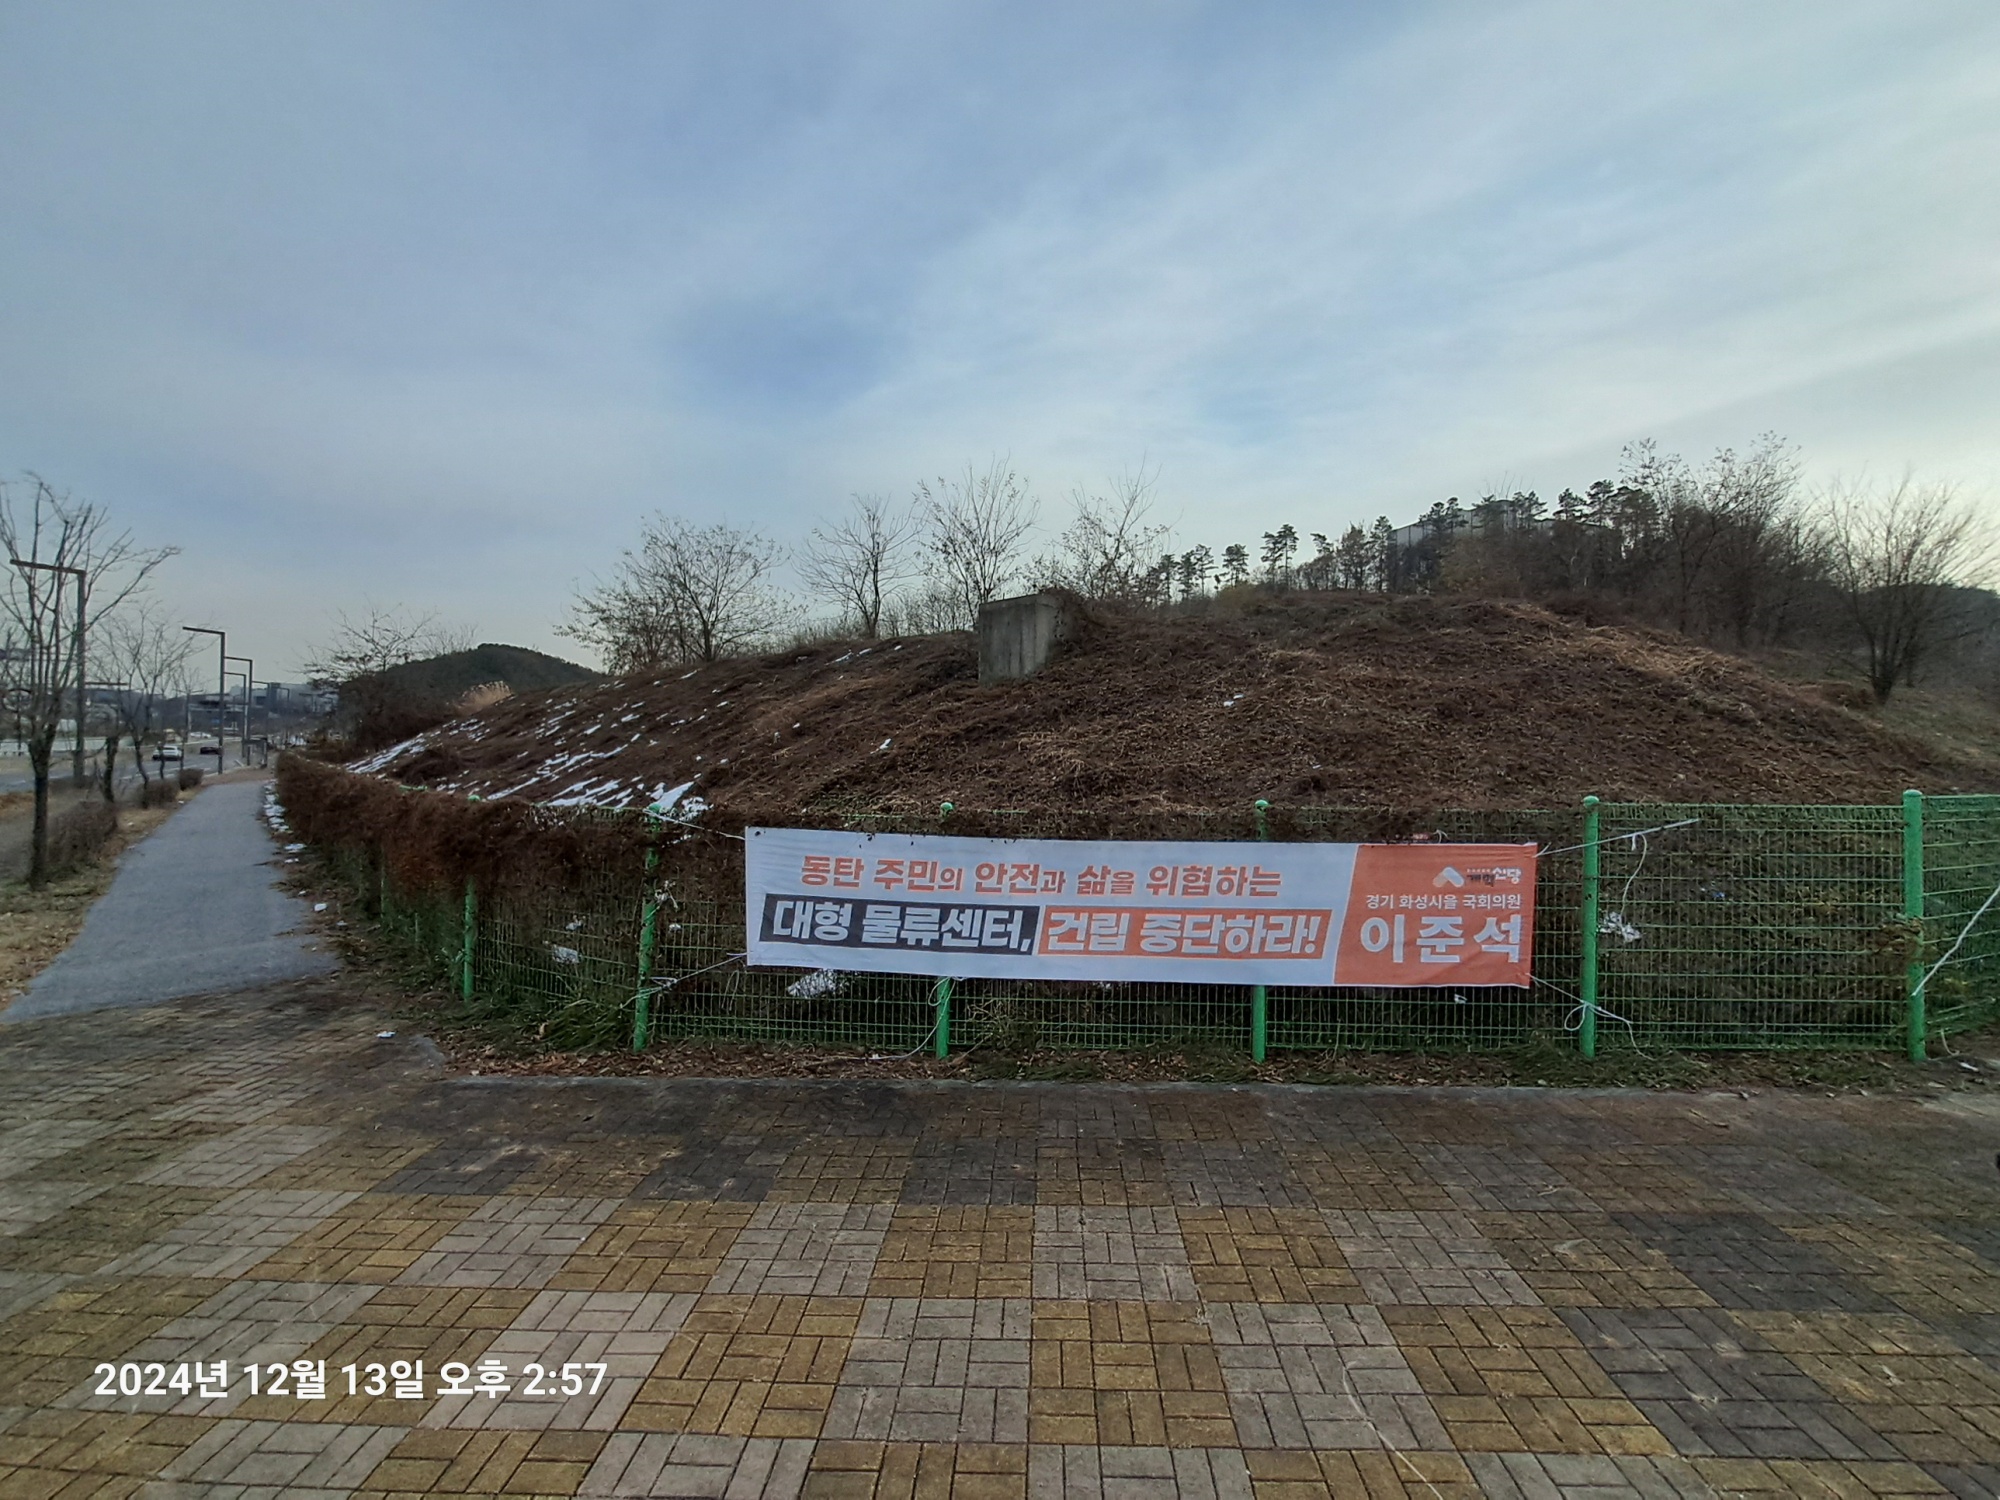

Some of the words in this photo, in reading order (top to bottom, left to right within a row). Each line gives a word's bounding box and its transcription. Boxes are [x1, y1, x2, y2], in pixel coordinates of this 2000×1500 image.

[801, 855, 865, 889] 동탄
[873, 858, 964, 892] 주민의
[974, 862, 1066, 895] 안전과
[1077, 865, 1135, 895] 삶을
[1147, 864, 1282, 897] 위협하는
[1366, 894, 1394, 909] 경기
[1399, 894, 1458, 910] 화성시을
[1462, 894, 1521, 910] 국회의원
[773, 900, 852, 942] 대형
[862, 904, 1031, 952] 물류센터,
[1047, 911, 1131, 952] 건립
[1139, 913, 1321, 955] 중단하라!
